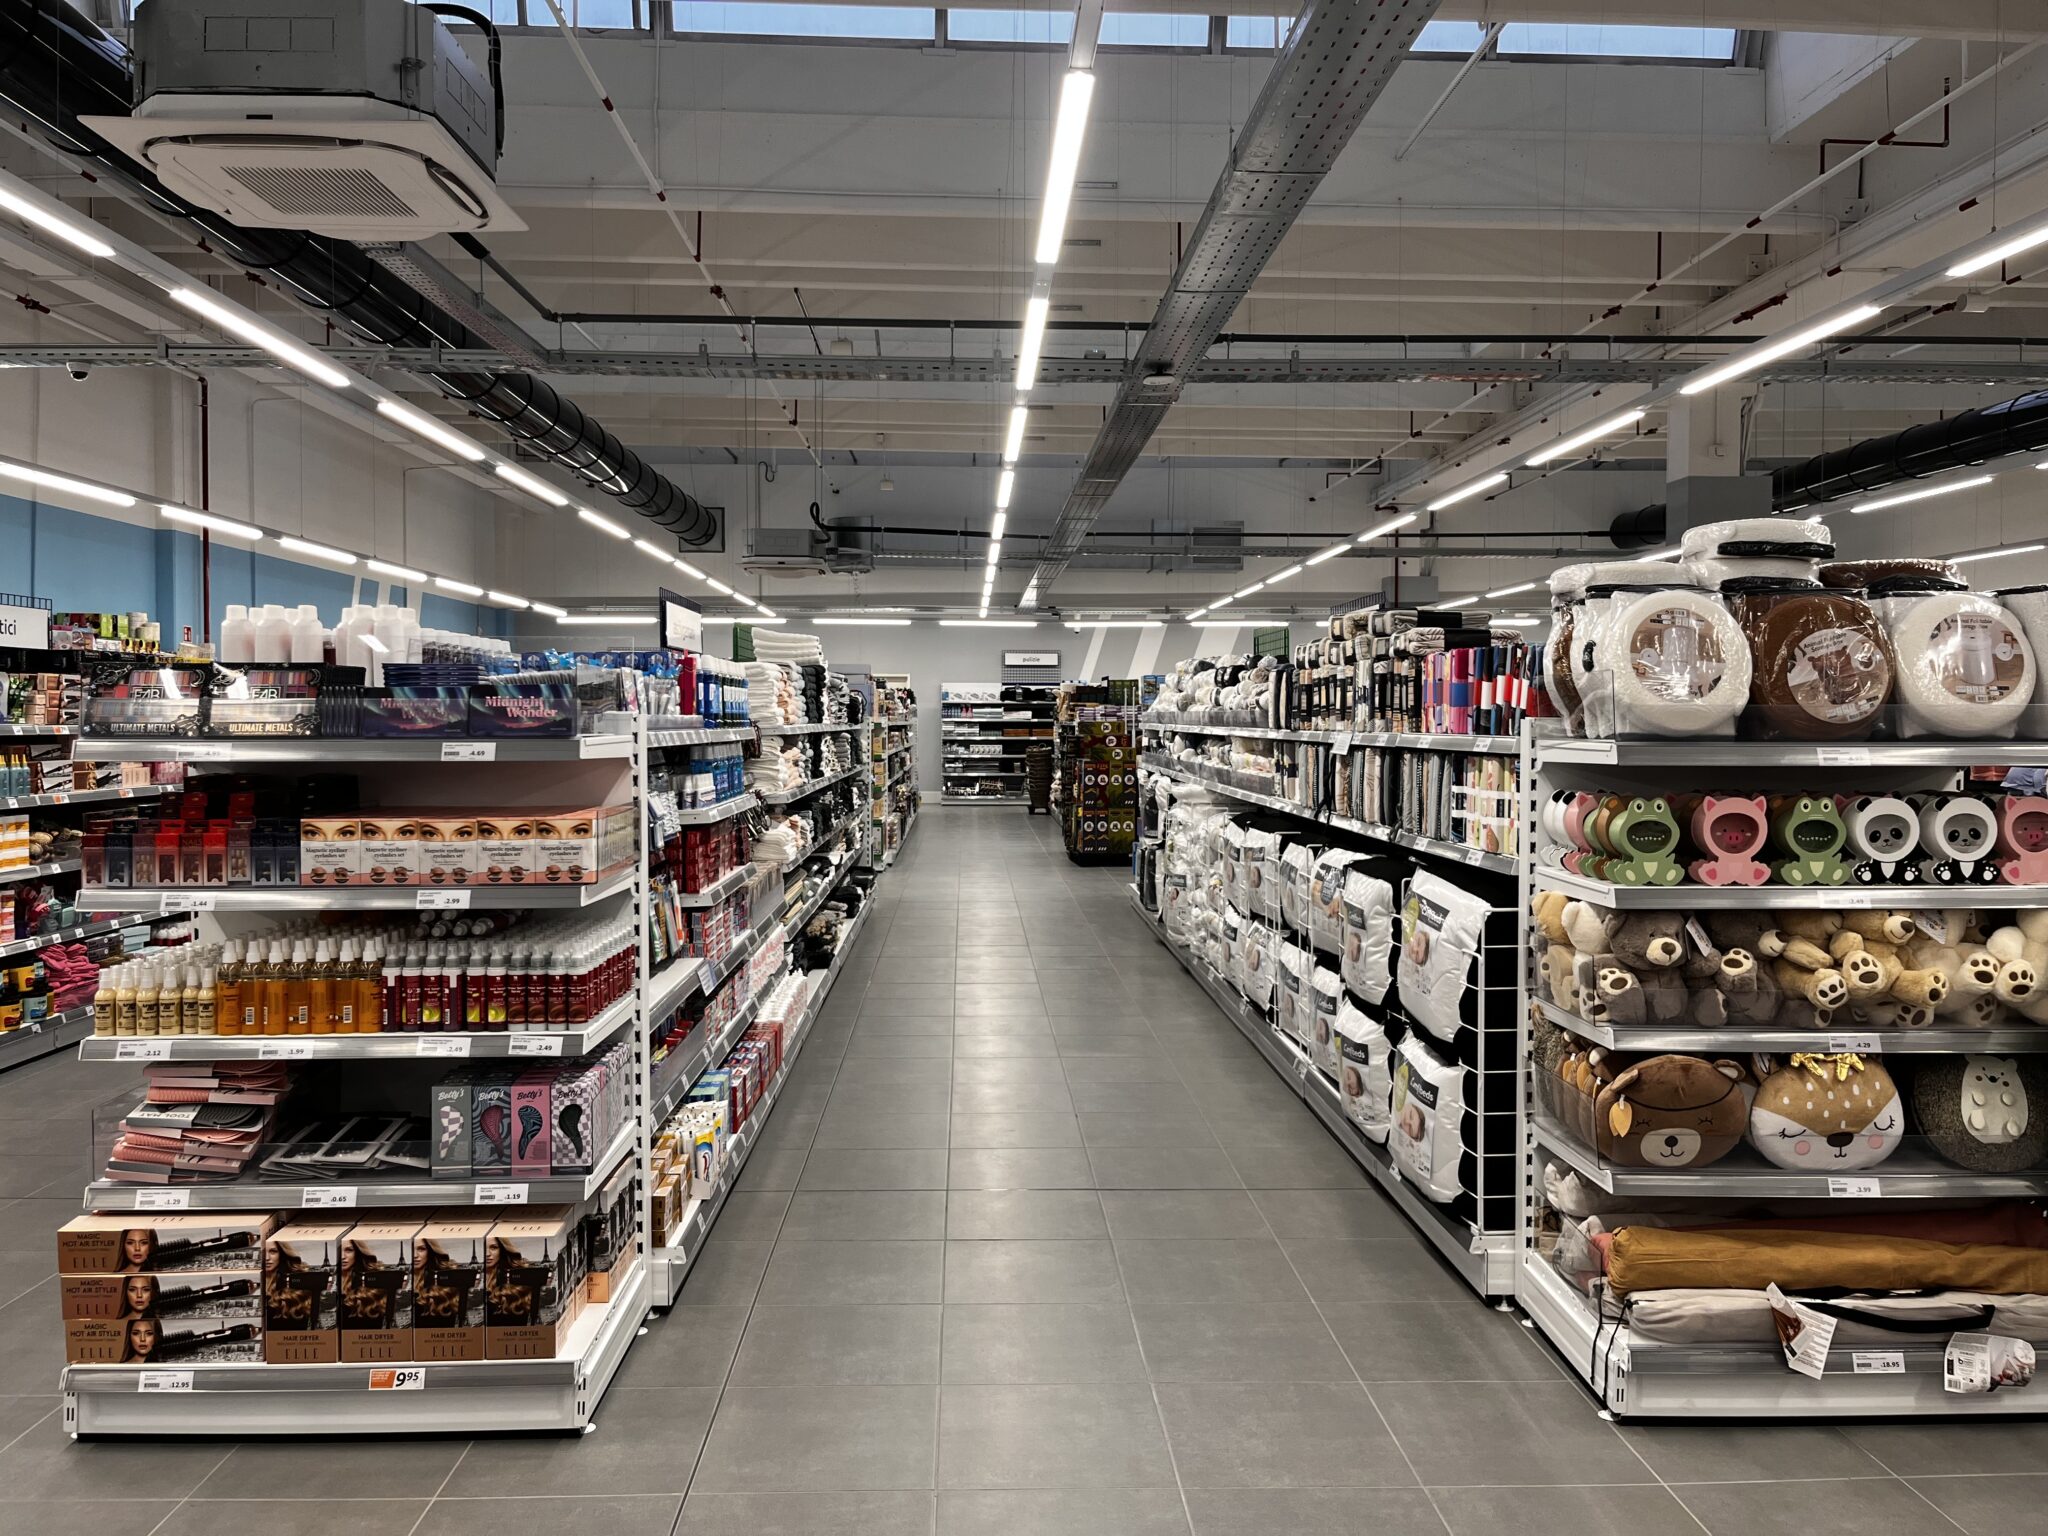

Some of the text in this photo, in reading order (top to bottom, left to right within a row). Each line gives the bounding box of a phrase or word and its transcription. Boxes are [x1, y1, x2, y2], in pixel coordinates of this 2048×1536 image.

[485, 695, 545, 709] Midnight
[506, 706, 558, 718] Wonder
[110, 723, 176, 733] ULTIMATE METALS
[229, 723, 294, 733] ULTIMATE METALS
[438, 1087, 465, 1100] Betty's
[478, 1088, 505, 1101] Betty's
[516, 1088, 543, 1100] Betty's
